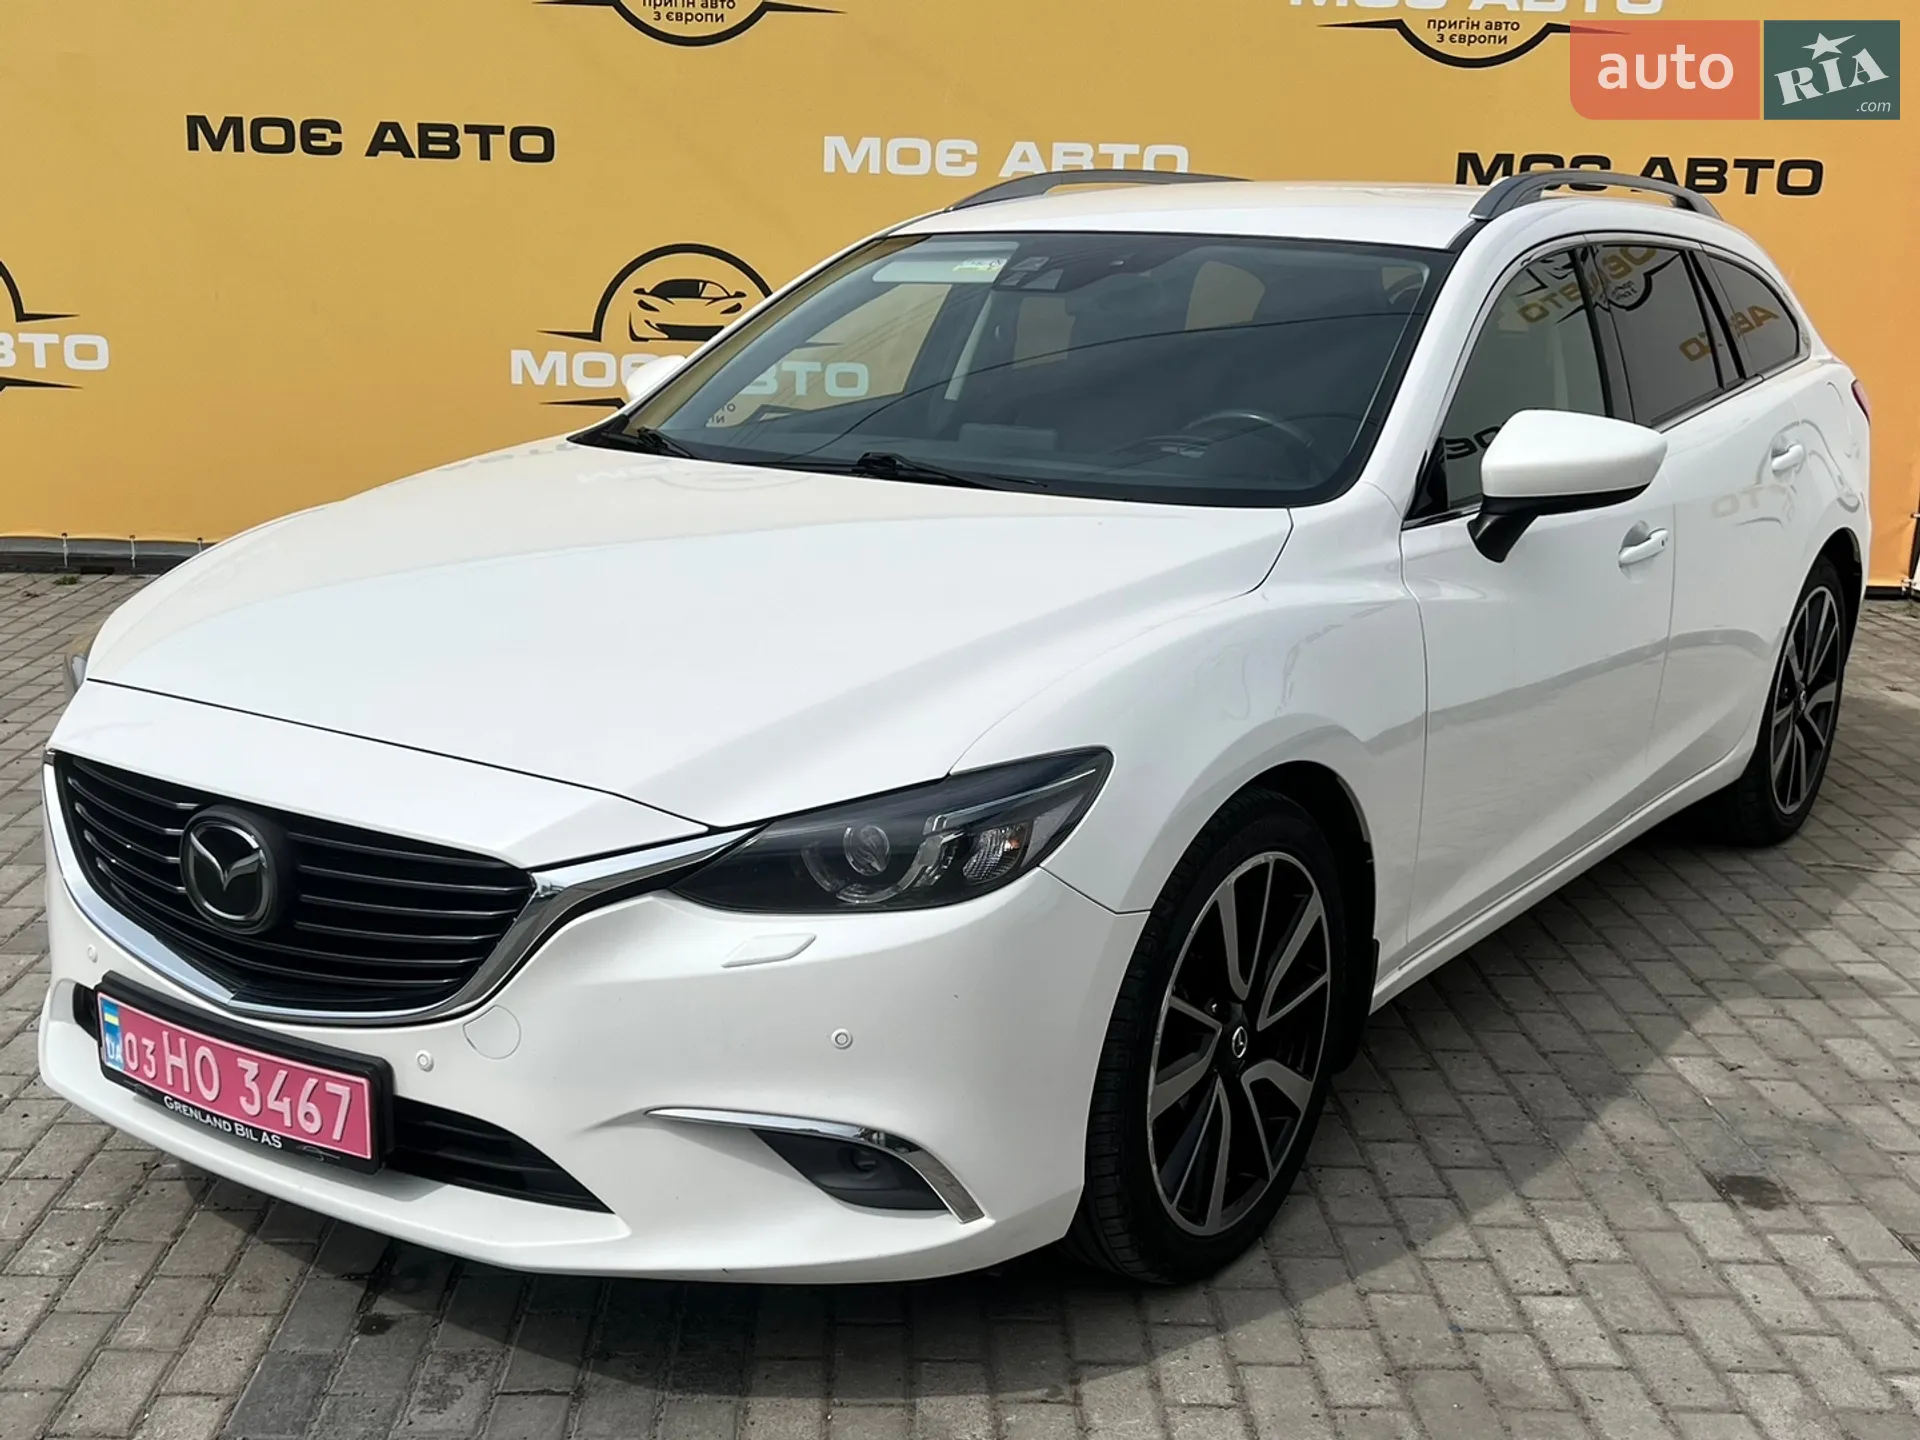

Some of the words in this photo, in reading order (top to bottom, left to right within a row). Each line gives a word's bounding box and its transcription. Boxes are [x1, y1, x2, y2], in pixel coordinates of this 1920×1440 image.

[653, 11, 661, 21] з
[666, 11, 725, 24] європи
[1427, 17, 1480, 32] пригін
[1484, 20, 1520, 31] авто
[1436, 33, 1445, 43] з
[1449, 33, 1508, 46] європи
[186, 114, 343, 156] МОЄ
[364, 121, 556, 163] АВТО
[823, 136, 978, 176] МОЄ
[998, 141, 1189, 177] АВТО
[1630, 157, 1824, 196] АВТО
[124, 1032, 157, 1079] 03
[237, 1057, 350, 1141] 3467
[234, 1122, 258, 1142] BIL
[261, 1131, 282, 1149] AS
